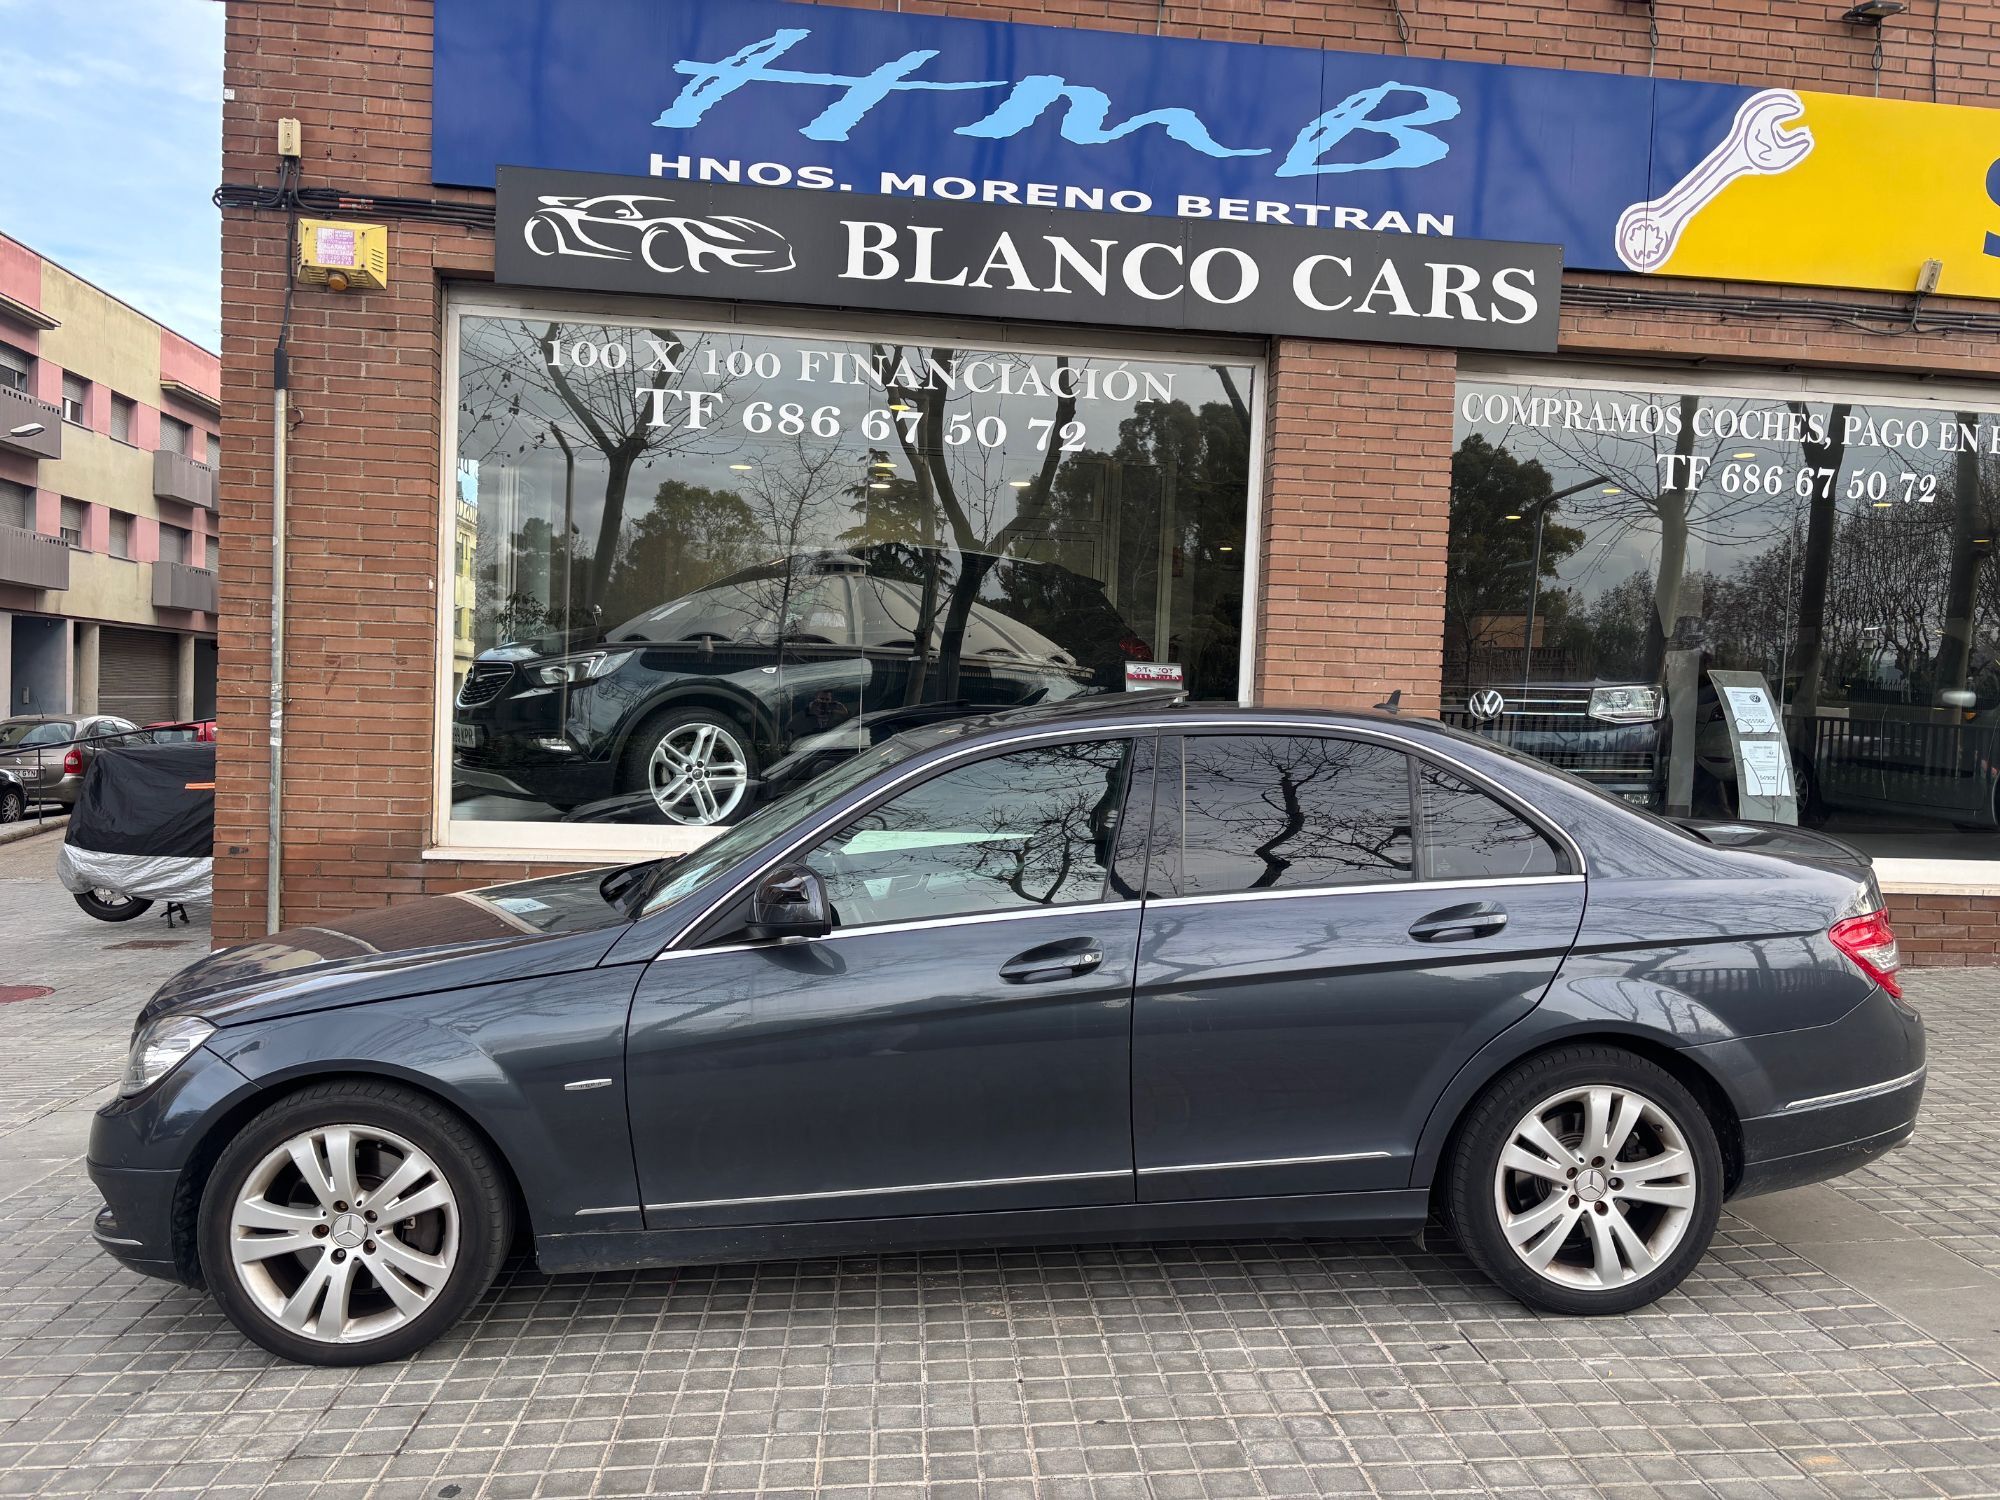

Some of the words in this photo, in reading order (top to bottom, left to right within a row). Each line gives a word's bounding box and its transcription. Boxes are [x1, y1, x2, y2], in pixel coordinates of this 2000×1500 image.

[649, 153, 852, 191] HNOS.
[881, 172, 1152, 213] MORENO
[1177, 194, 1454, 237] BERTRAN
[838, 220, 1260, 304] BLANCO
[1292, 254, 1538, 325] CARS
[547, 340, 627, 370] 100
[643, 340, 682, 373] X
[703, 349, 781, 379] 100
[796, 349, 1178, 404] FINANCIACIÓN
[635, 387, 723, 430] TF
[742, 401, 841, 438] 686
[861, 409, 924, 444] 67
[944, 412, 1007, 448] 50
[1027, 417, 1087, 453] 72
[1461, 392, 1682, 436] COMPRAMOS
[1692, 407, 1831, 450] COCHES,
[1841, 415, 1929, 449] PAGO
[1937, 422, 1981, 453] EN
[1656, 453, 1711, 491] TF
[1721, 463, 1784, 495] 686
[1795, 467, 1835, 498] 67
[1847, 468, 1887, 500] 50
[1899, 471, 1936, 503] 72
